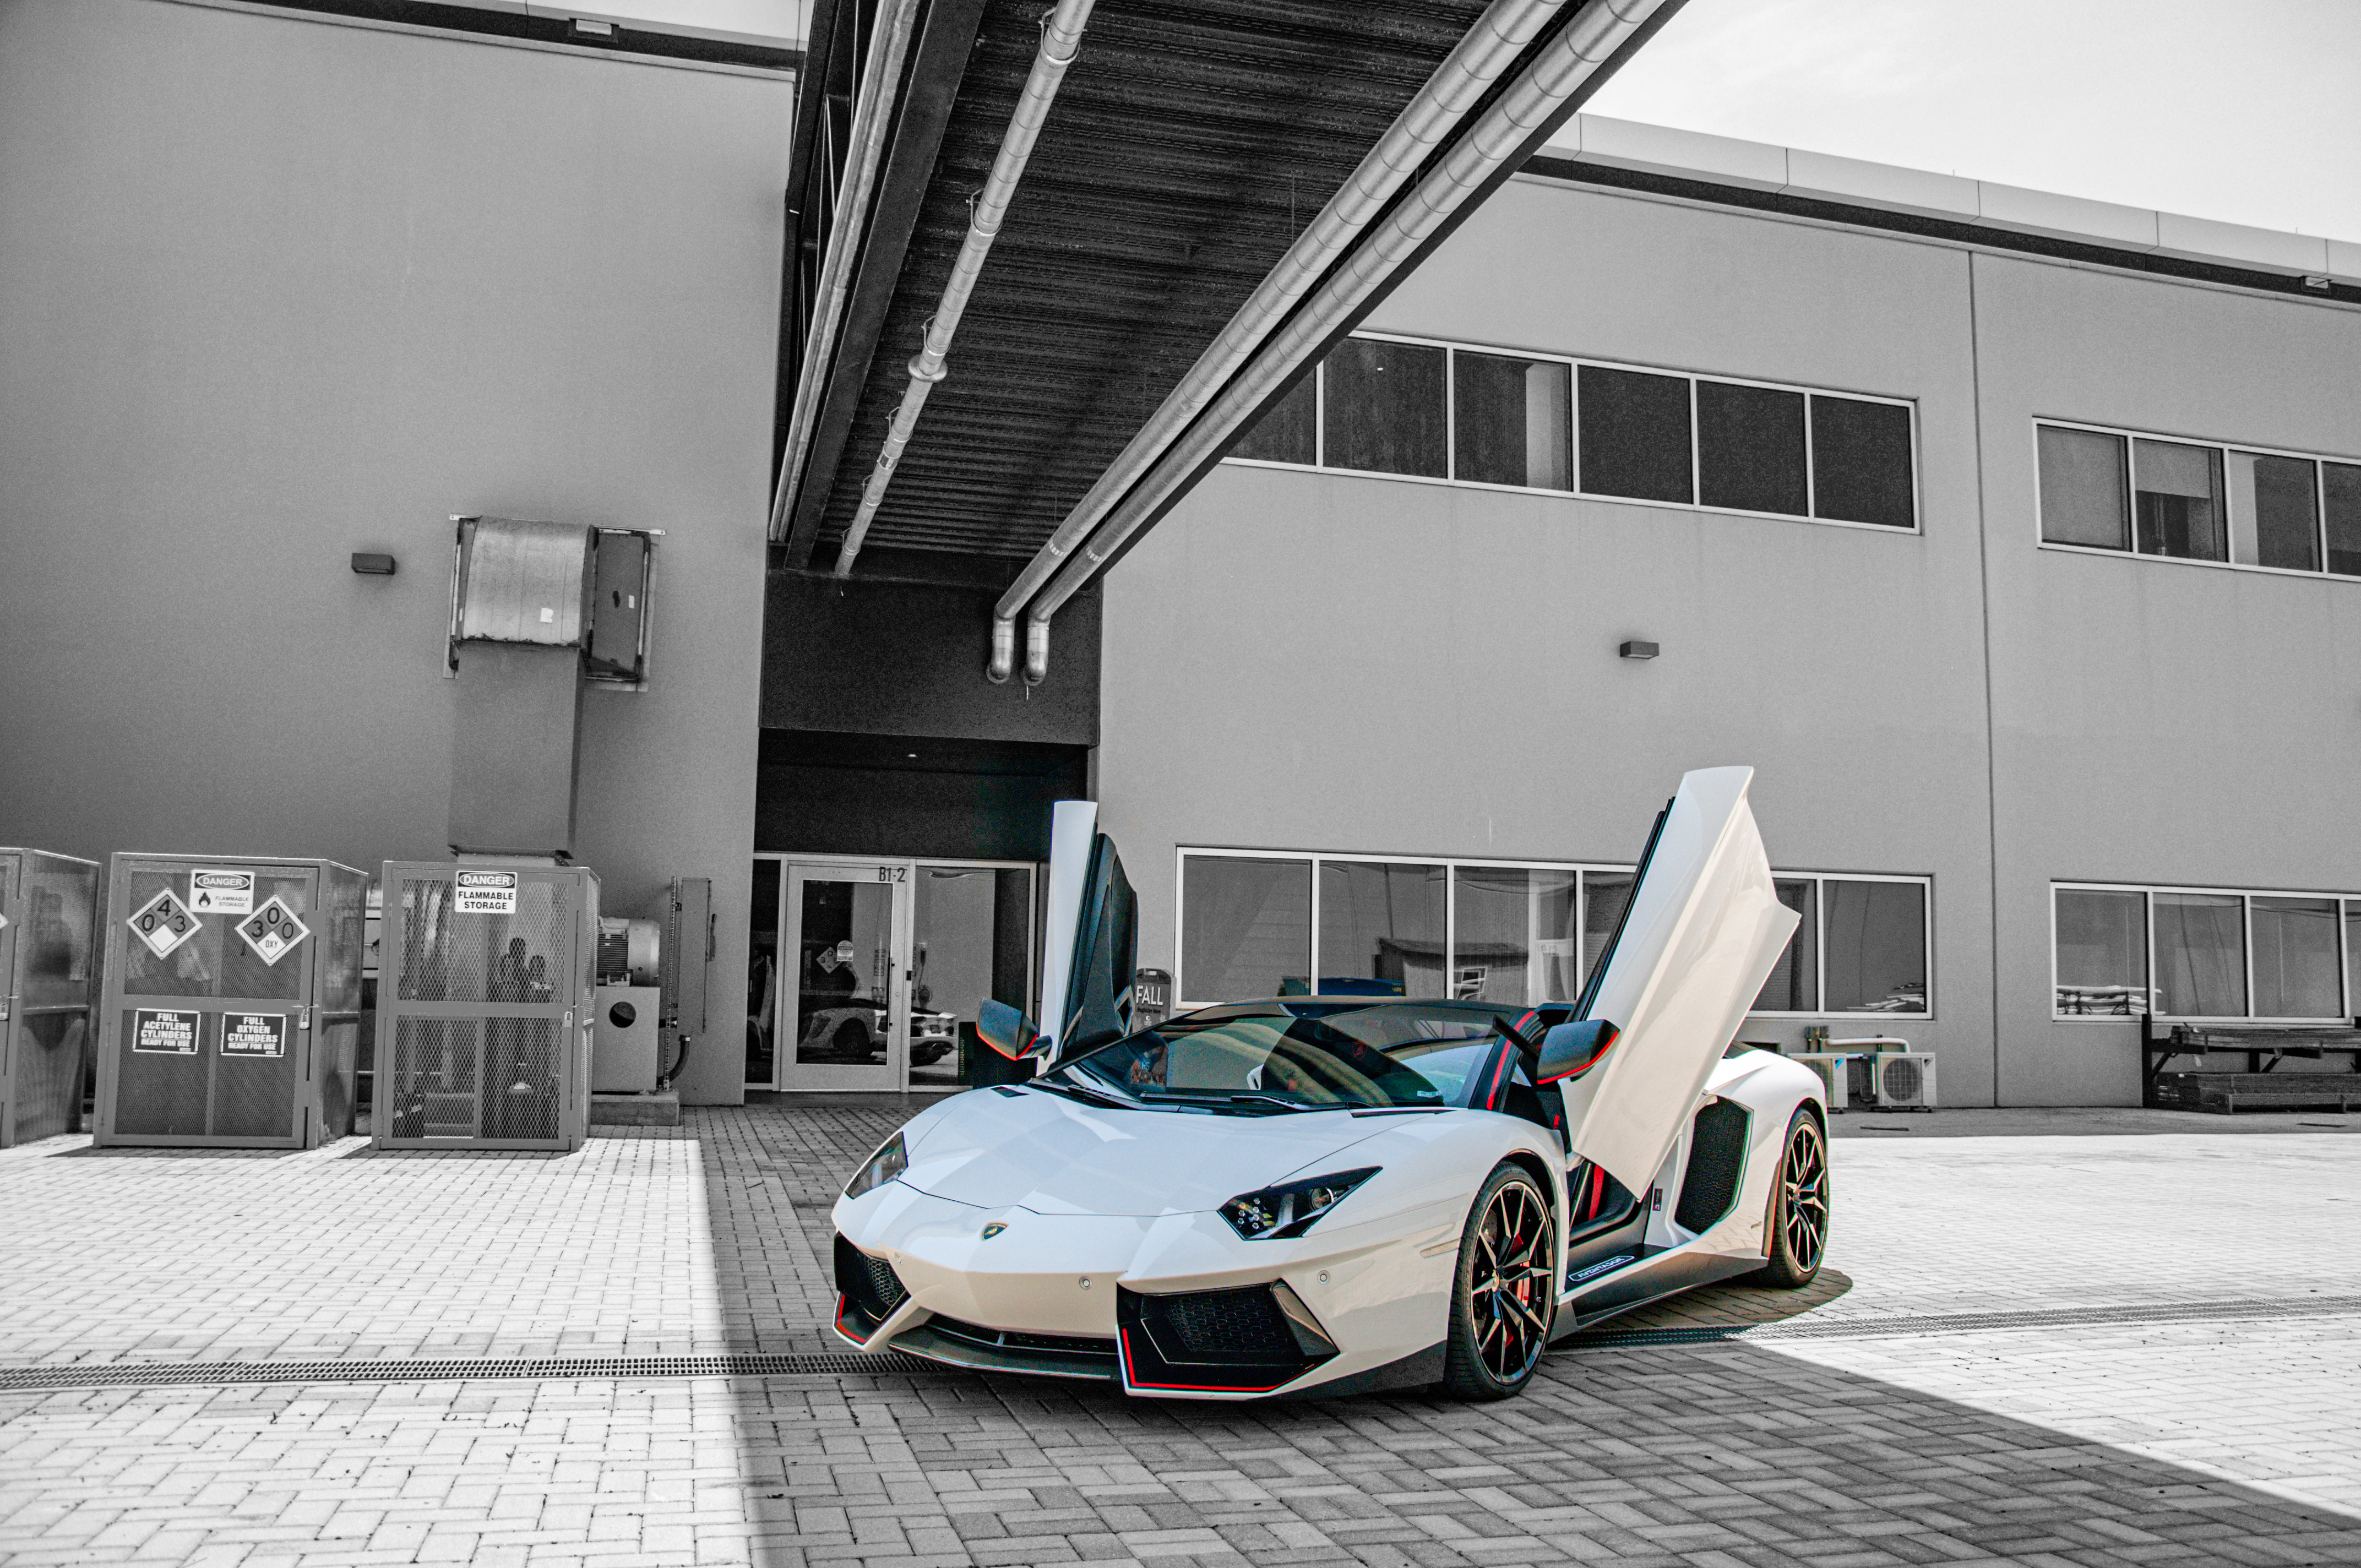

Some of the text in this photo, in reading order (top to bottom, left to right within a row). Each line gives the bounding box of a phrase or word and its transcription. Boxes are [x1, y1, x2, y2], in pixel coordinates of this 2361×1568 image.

[879, 866, 905, 882] B1-2
[203, 877, 243, 886] DANGER
[464, 875, 511, 885] DANGER
[458, 891, 514, 900] FLAMMABLE
[157, 899, 171, 917] 4
[464, 901, 507, 910] STORAGE
[267, 907, 280, 924] 0
[142, 913, 186, 932] 0 3
[251, 920, 294, 939] 3 0
[265, 939, 278, 949] OXY
[1136, 985, 1163, 1006] FALL
[157, 1013, 179, 1022] FULL
[243, 1016, 265, 1025] FULL
[143, 1020, 191, 1031] ACETYLENE
[236, 1025, 270, 1034] OXYGEN
[140, 1029, 192, 1039] CYLINDERS
[227, 1033, 278, 1043] CYLINDERS
